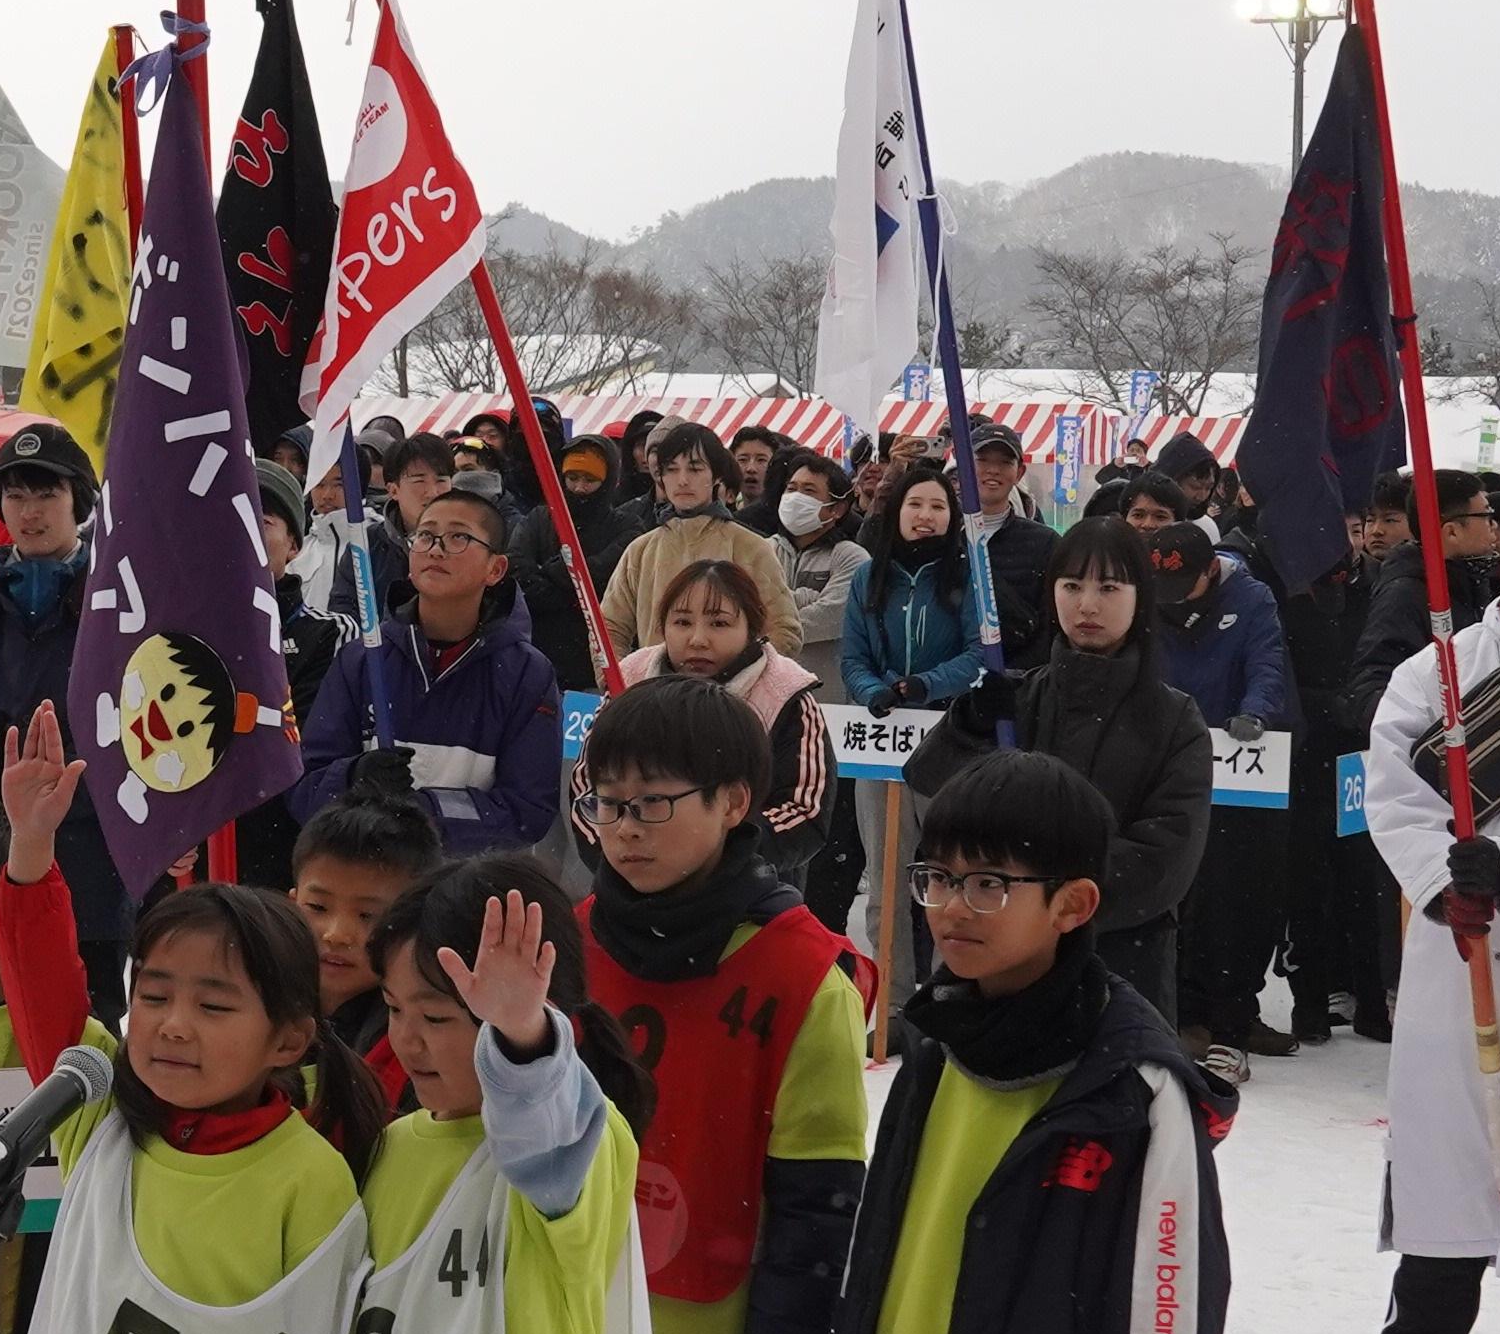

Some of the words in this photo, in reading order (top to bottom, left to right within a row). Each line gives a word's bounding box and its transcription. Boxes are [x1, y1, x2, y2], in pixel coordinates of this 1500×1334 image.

[363, 102, 390, 133] TEAM
[1344, 774, 1363, 812] 26
[718, 985, 778, 1049] 44
[1159, 1200, 1178, 1259] new
